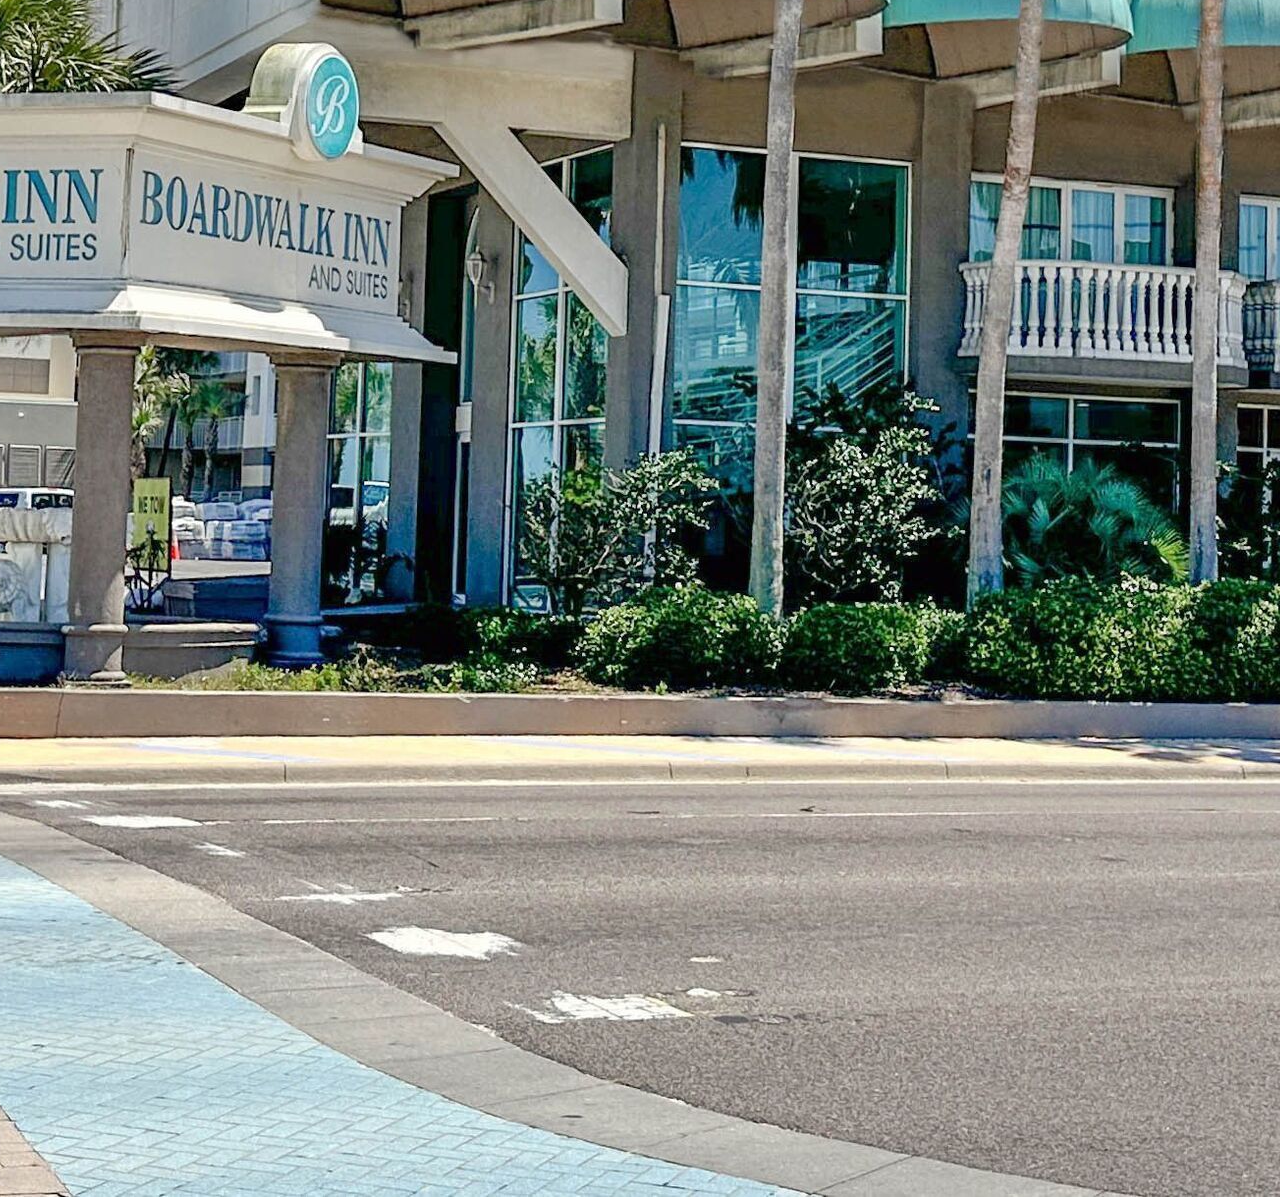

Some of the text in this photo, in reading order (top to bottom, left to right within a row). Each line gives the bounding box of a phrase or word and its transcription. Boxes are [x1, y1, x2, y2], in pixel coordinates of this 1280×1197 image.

[312, 75, 351, 138] B
[1, 168, 104, 225] INN
[139, 169, 392, 268] BOARDWALK INN
[9, 232, 98, 262] SUITES
[308, 264, 389, 300] AND SUITES
